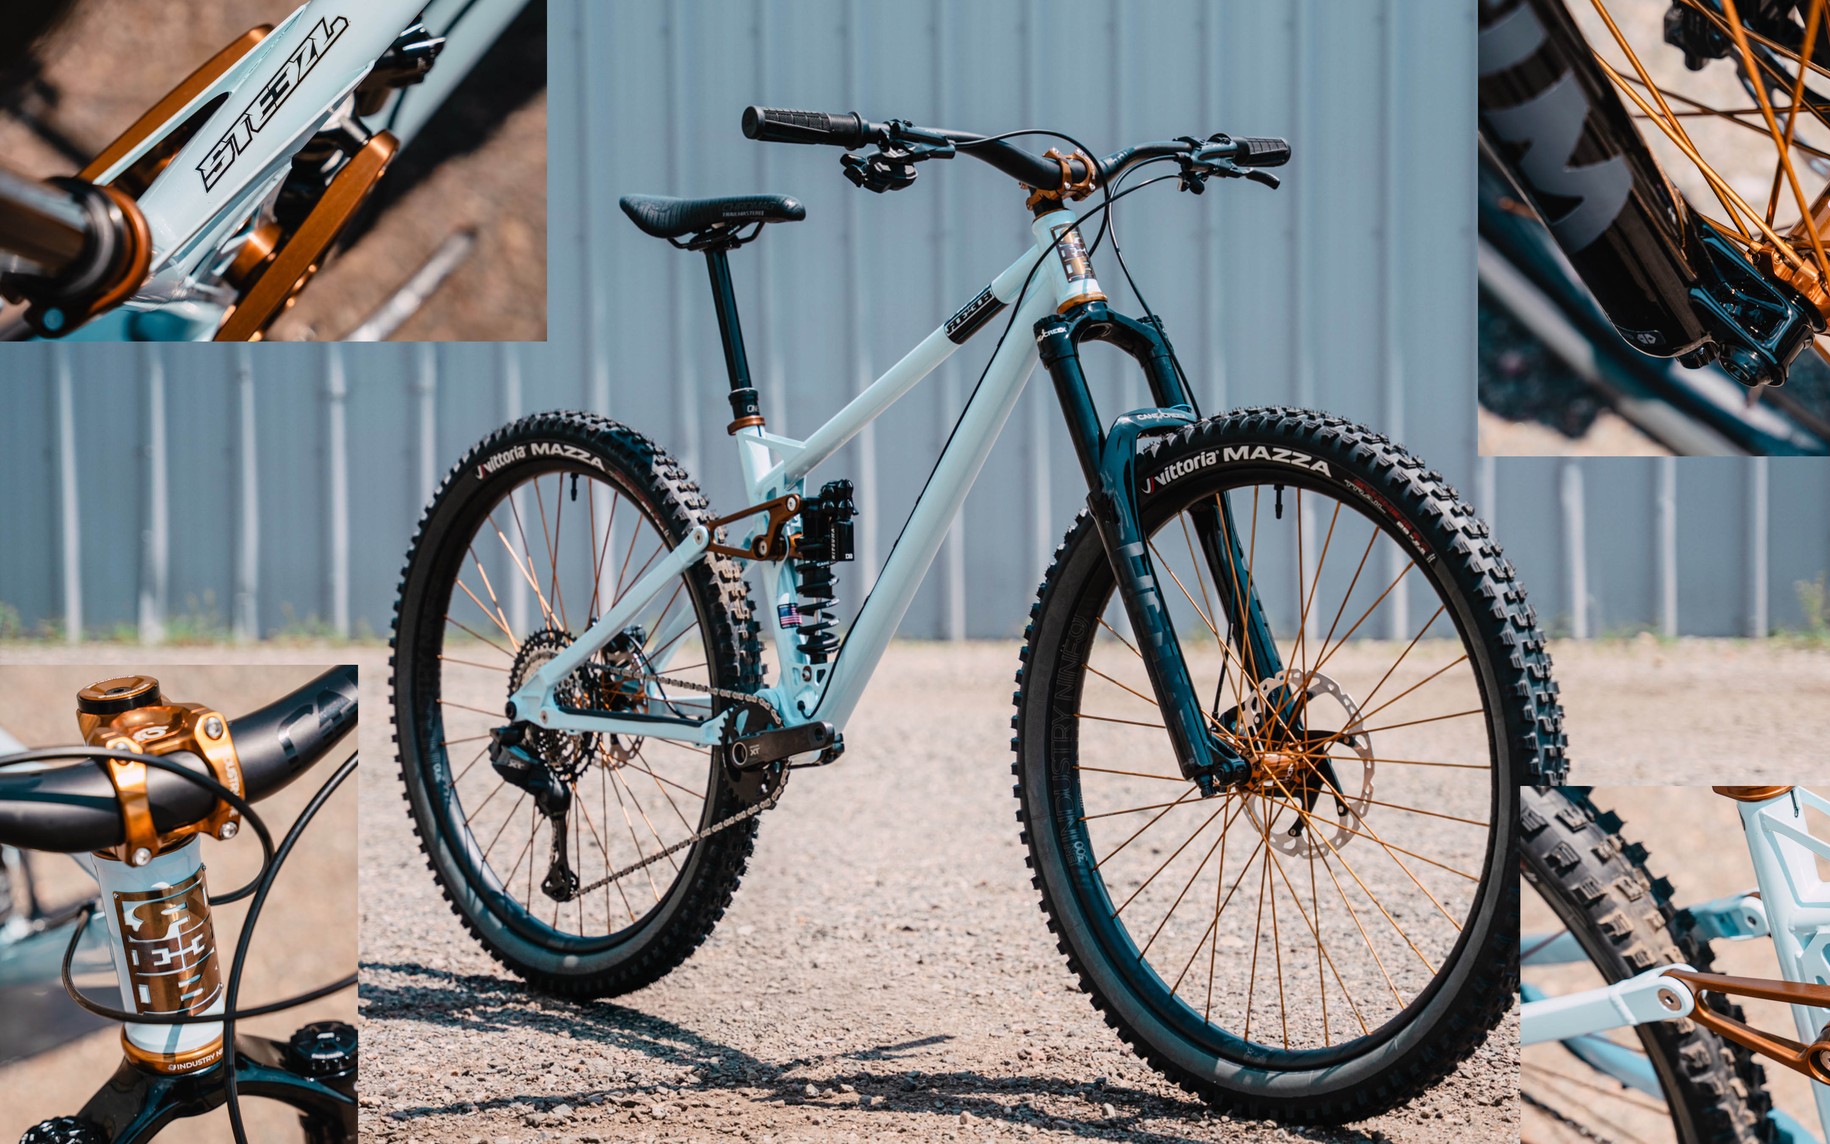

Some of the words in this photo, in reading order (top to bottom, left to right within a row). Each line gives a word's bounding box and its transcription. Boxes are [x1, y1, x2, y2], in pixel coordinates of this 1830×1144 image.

[483, 444, 526, 473] vittoria
[531, 442, 606, 472] MAZZA
[1153, 450, 1217, 487] vittoria
[1223, 445, 1332, 478] MAZZA
[176, 1053, 216, 1071] INDUSTRY
